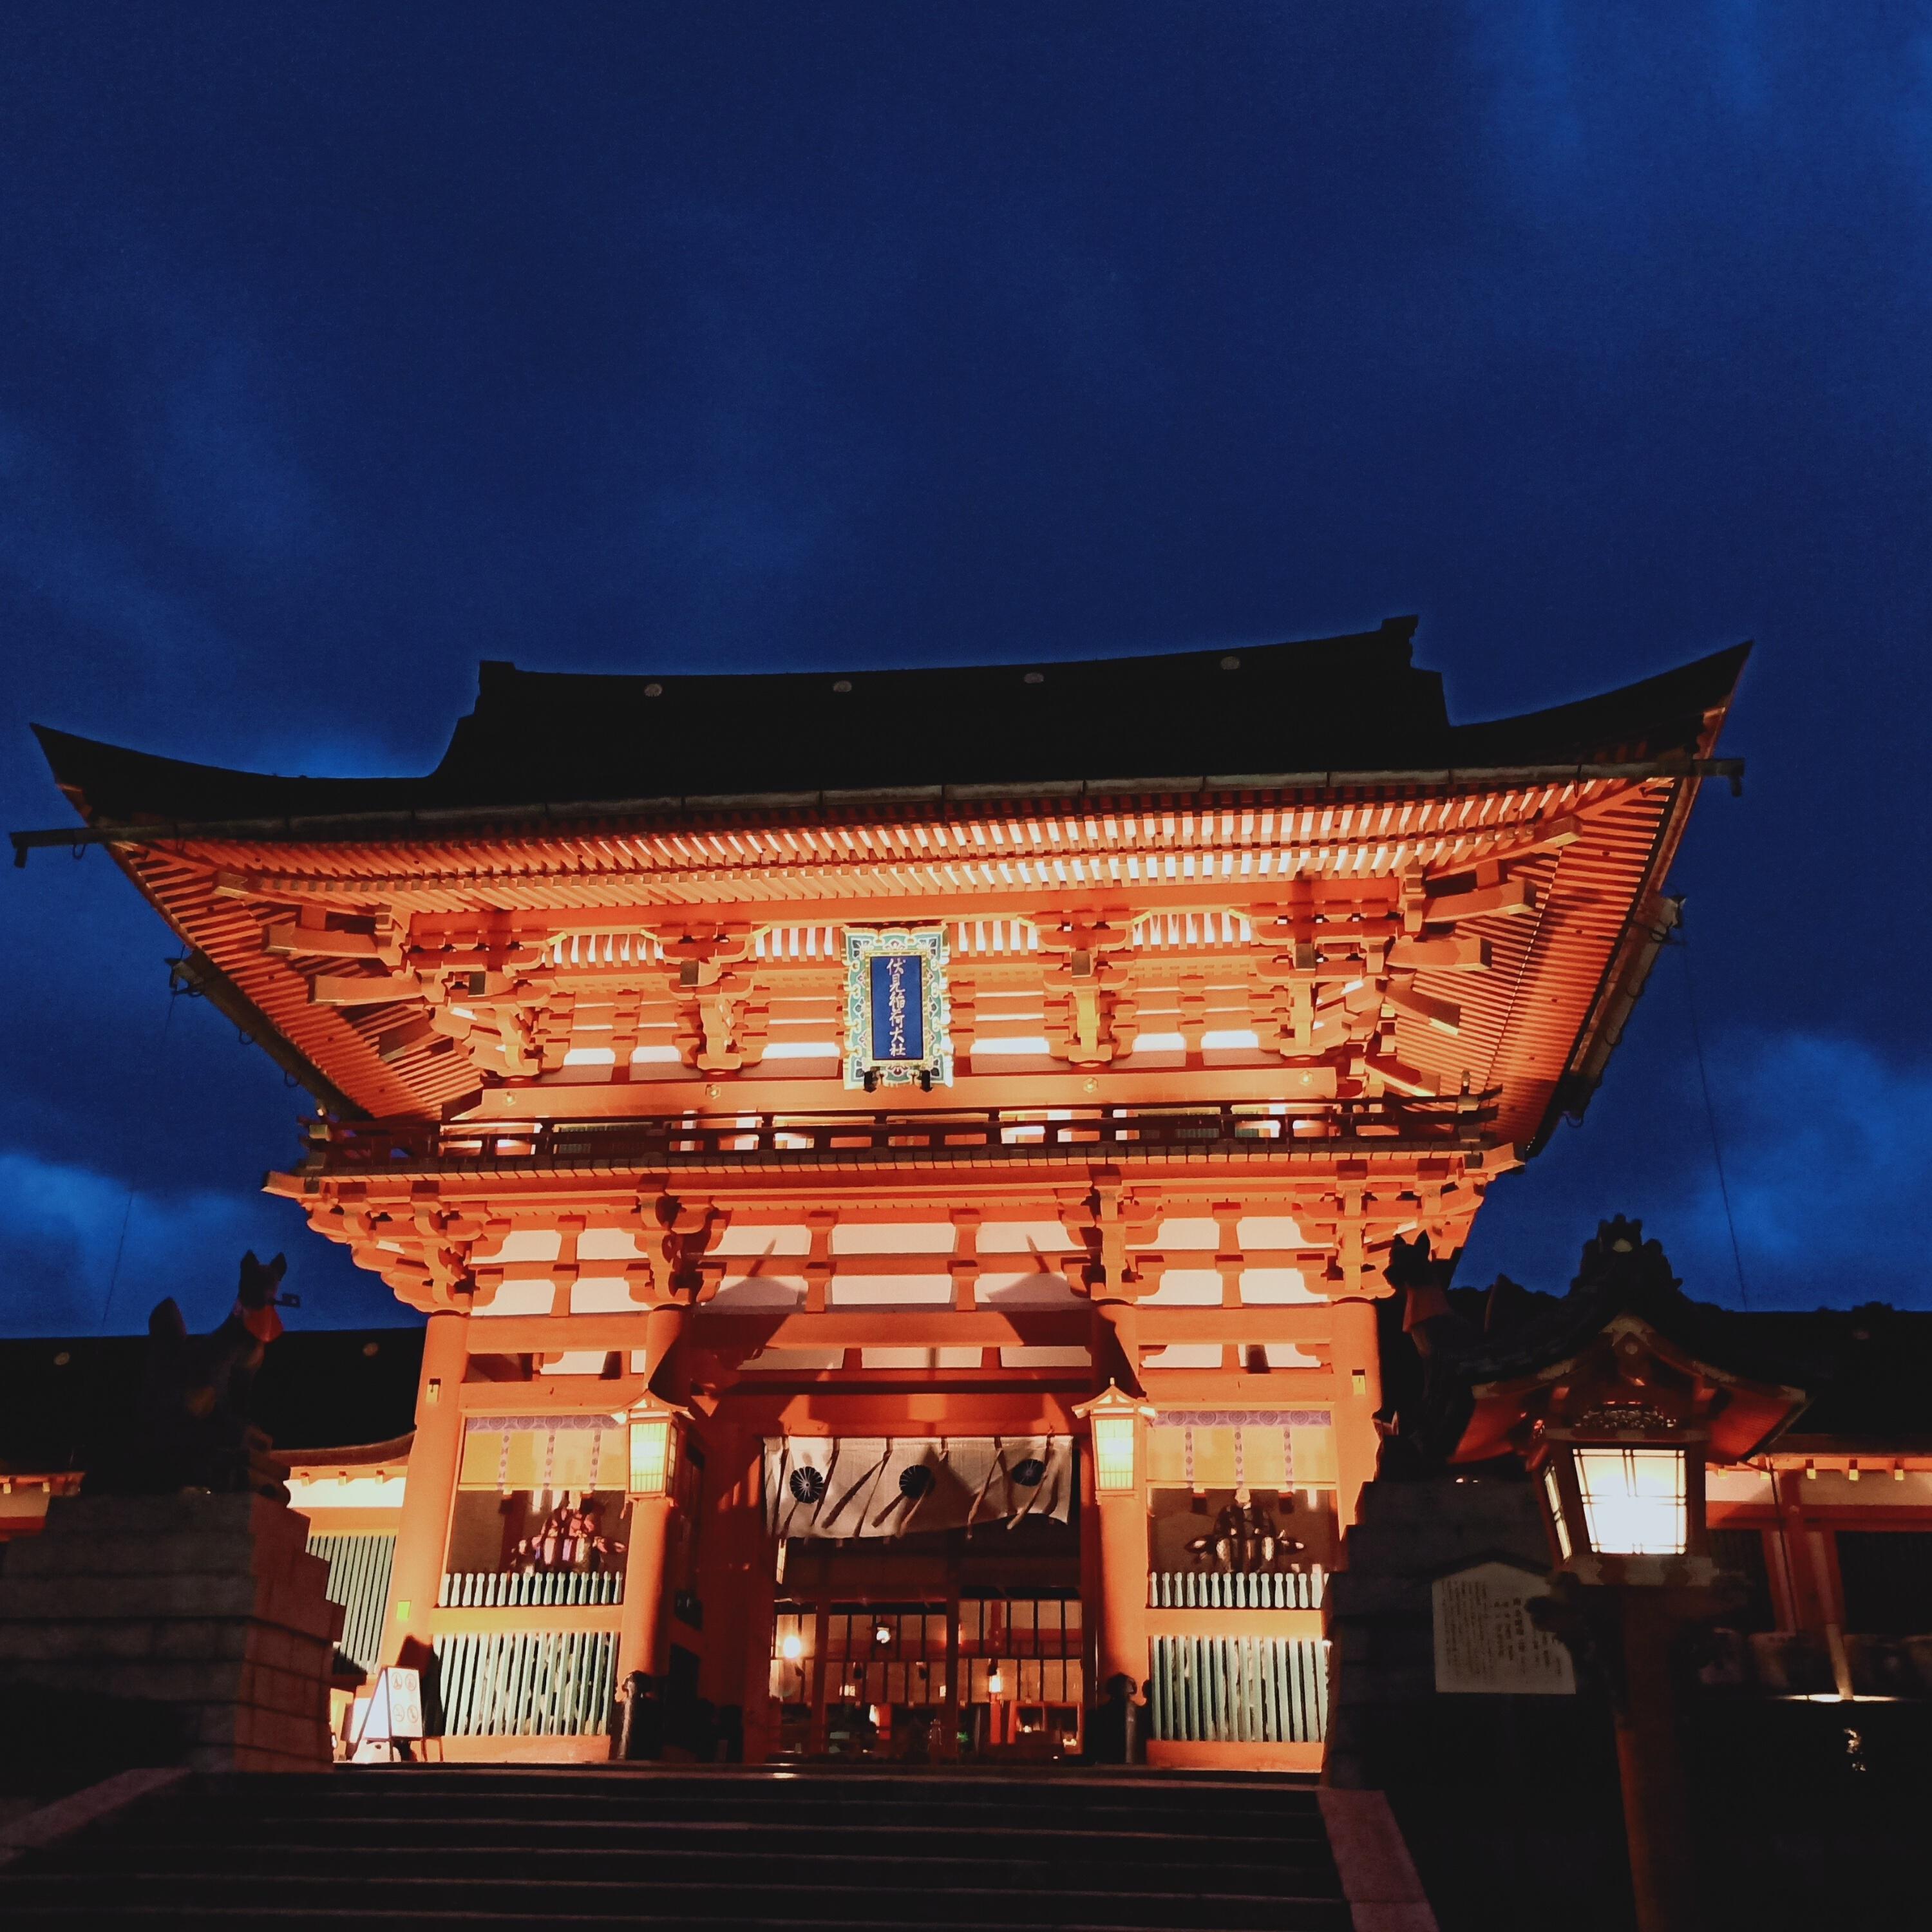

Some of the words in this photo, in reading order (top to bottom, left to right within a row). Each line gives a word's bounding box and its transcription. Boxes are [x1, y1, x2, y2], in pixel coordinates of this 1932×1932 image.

[886, 958, 907, 1057] 伏見稲荷大社
